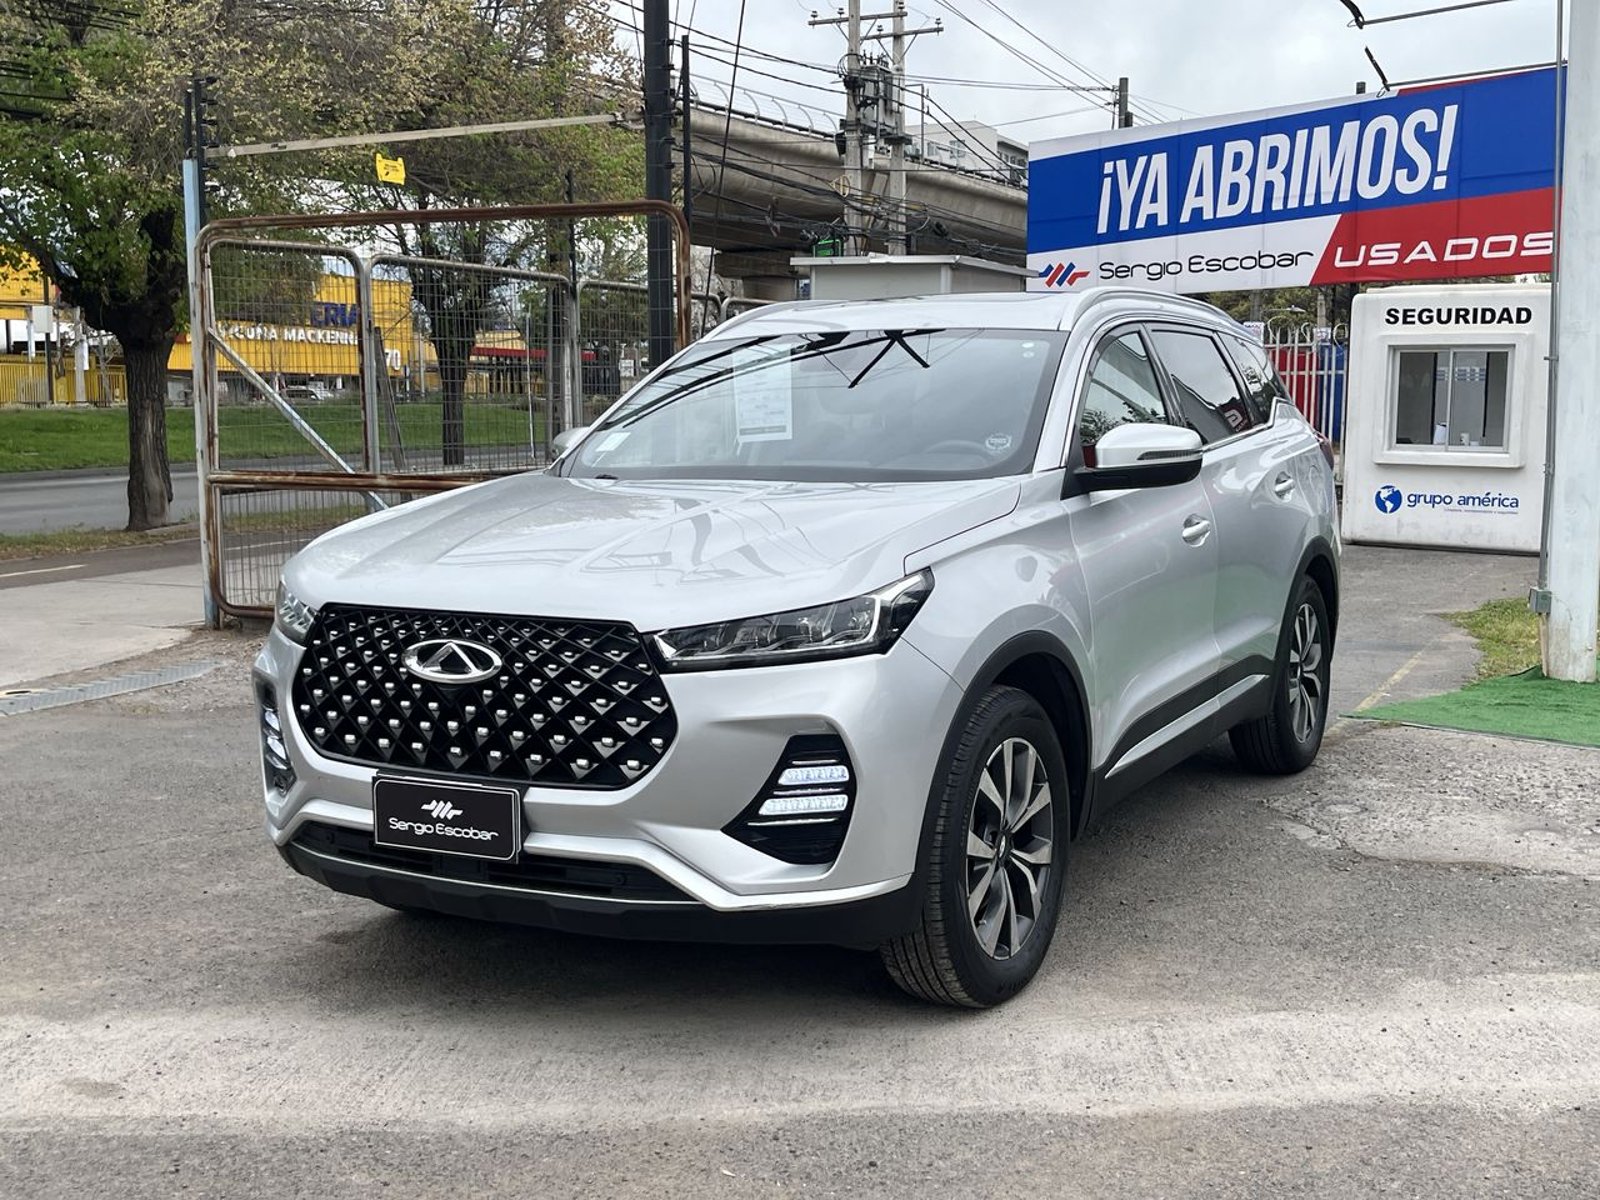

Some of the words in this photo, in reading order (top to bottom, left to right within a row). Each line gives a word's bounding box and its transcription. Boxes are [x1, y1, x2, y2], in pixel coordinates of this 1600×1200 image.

[1096, 152, 1169, 235] ¡YA
[1179, 104, 1459, 224] ABRIMOS!
[1334, 231, 1554, 269] USADOS
[1099, 261, 1183, 281] Sergio
[1188, 250, 1314, 273] Escobar
[1384, 306, 1533, 326] SEGURIDAD
[1406, 492, 1454, 509] grupo
[1456, 491, 1520, 509] américa
[435, 822, 500, 841] Escobar
